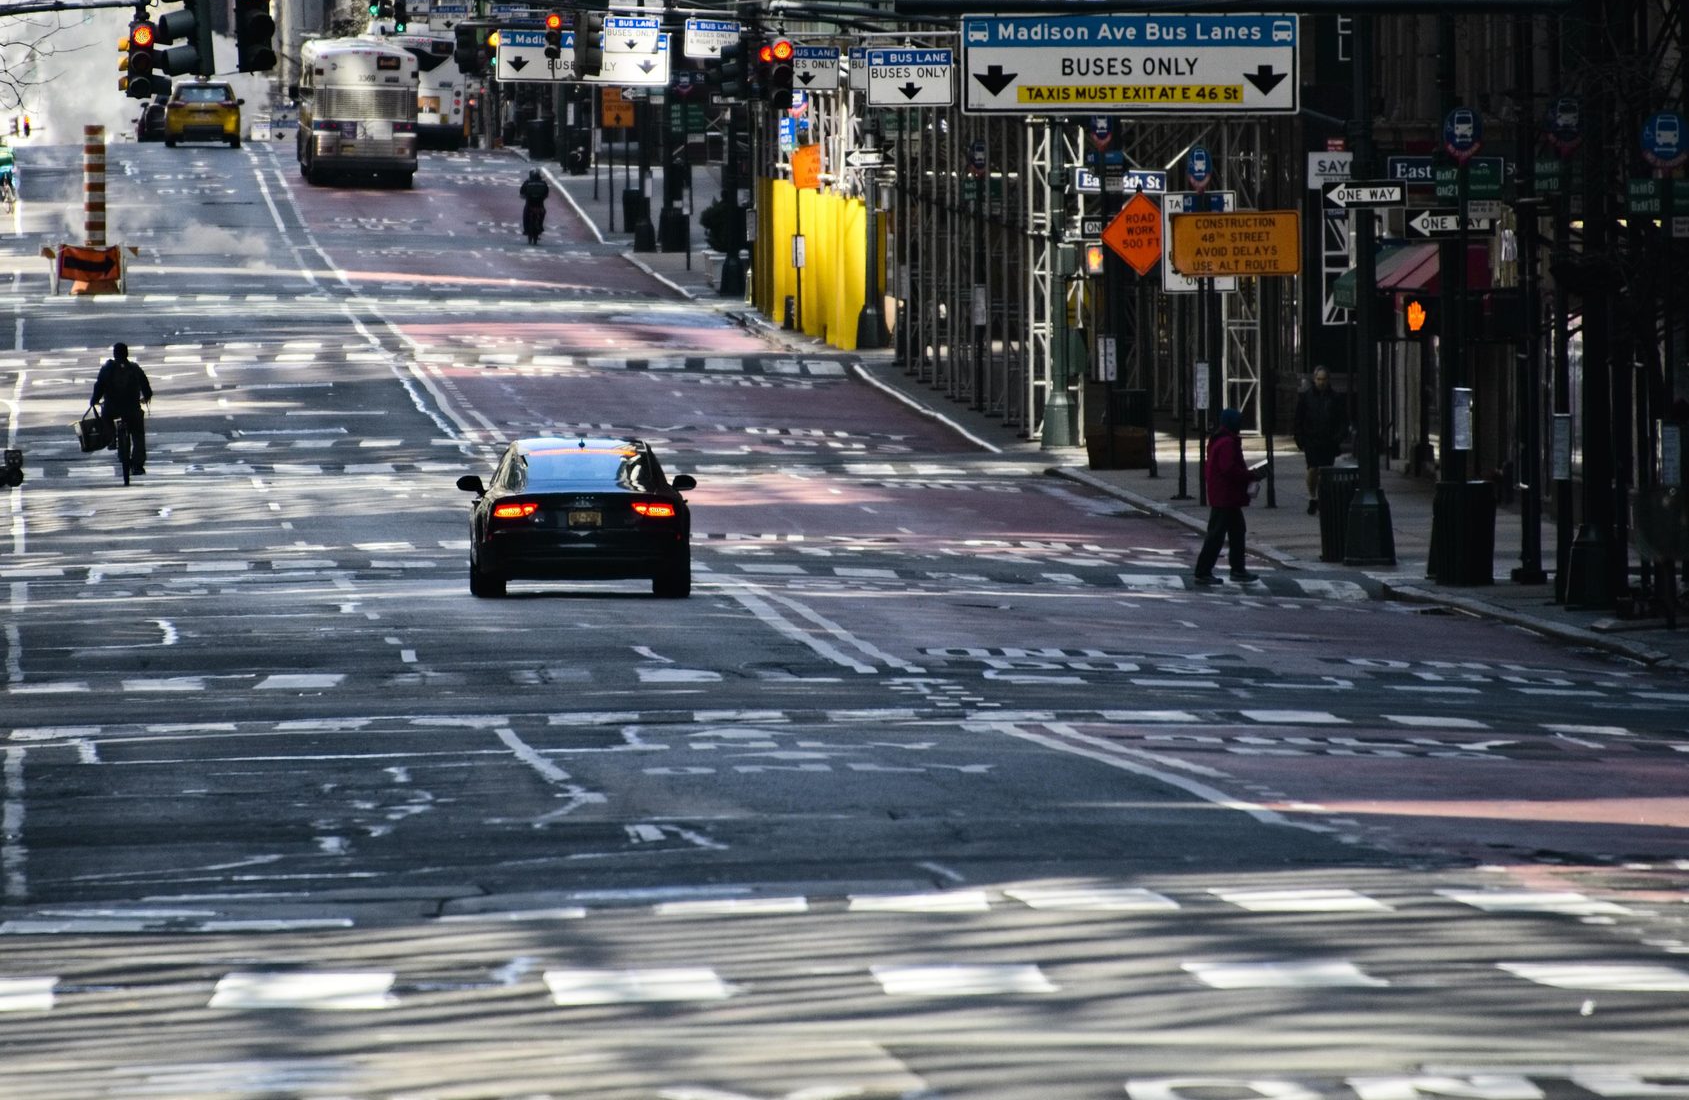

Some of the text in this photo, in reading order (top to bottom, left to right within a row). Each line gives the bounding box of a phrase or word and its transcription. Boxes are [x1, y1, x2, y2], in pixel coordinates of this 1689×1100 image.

[618, 19, 657, 28] BUS LANE
[700, 22, 738, 31] BUS LANE
[607, 28, 633, 37] BUSES
[997, 22, 1262, 40] Madison Ave Bus Lanes
[811, 49, 837, 58] LANE
[890, 53, 948, 64] BUS LANE
[811, 60, 836, 69] ONLY
[1061, 57, 1200, 76] BUSES ONLY
[871, 67, 949, 79] BUSES ONLY
[1026, 87, 1239, 100] TAXIS MUST EXIT AT E 46 St
[1395, 162, 1433, 180] East
[1145, 175, 1161, 188] St
[1630, 180, 1656, 195] BxM6
[1336, 188, 1396, 201] ONE WAY
[1125, 214, 1154, 224] ROAD
[1195, 217, 1276, 229] CONSTRUCTION
[1420, 217, 1447, 229] ONE
[1126, 225, 1156, 235] WORK
[1230, 231, 1271, 242] STREET
[1122, 238, 1160, 248] 500 FT
[1195, 245, 1278, 257] AVOID DELAYS
[1192, 260, 1280, 271] USE ALT ROUTE
[925, 647, 1222, 660] ONLY
